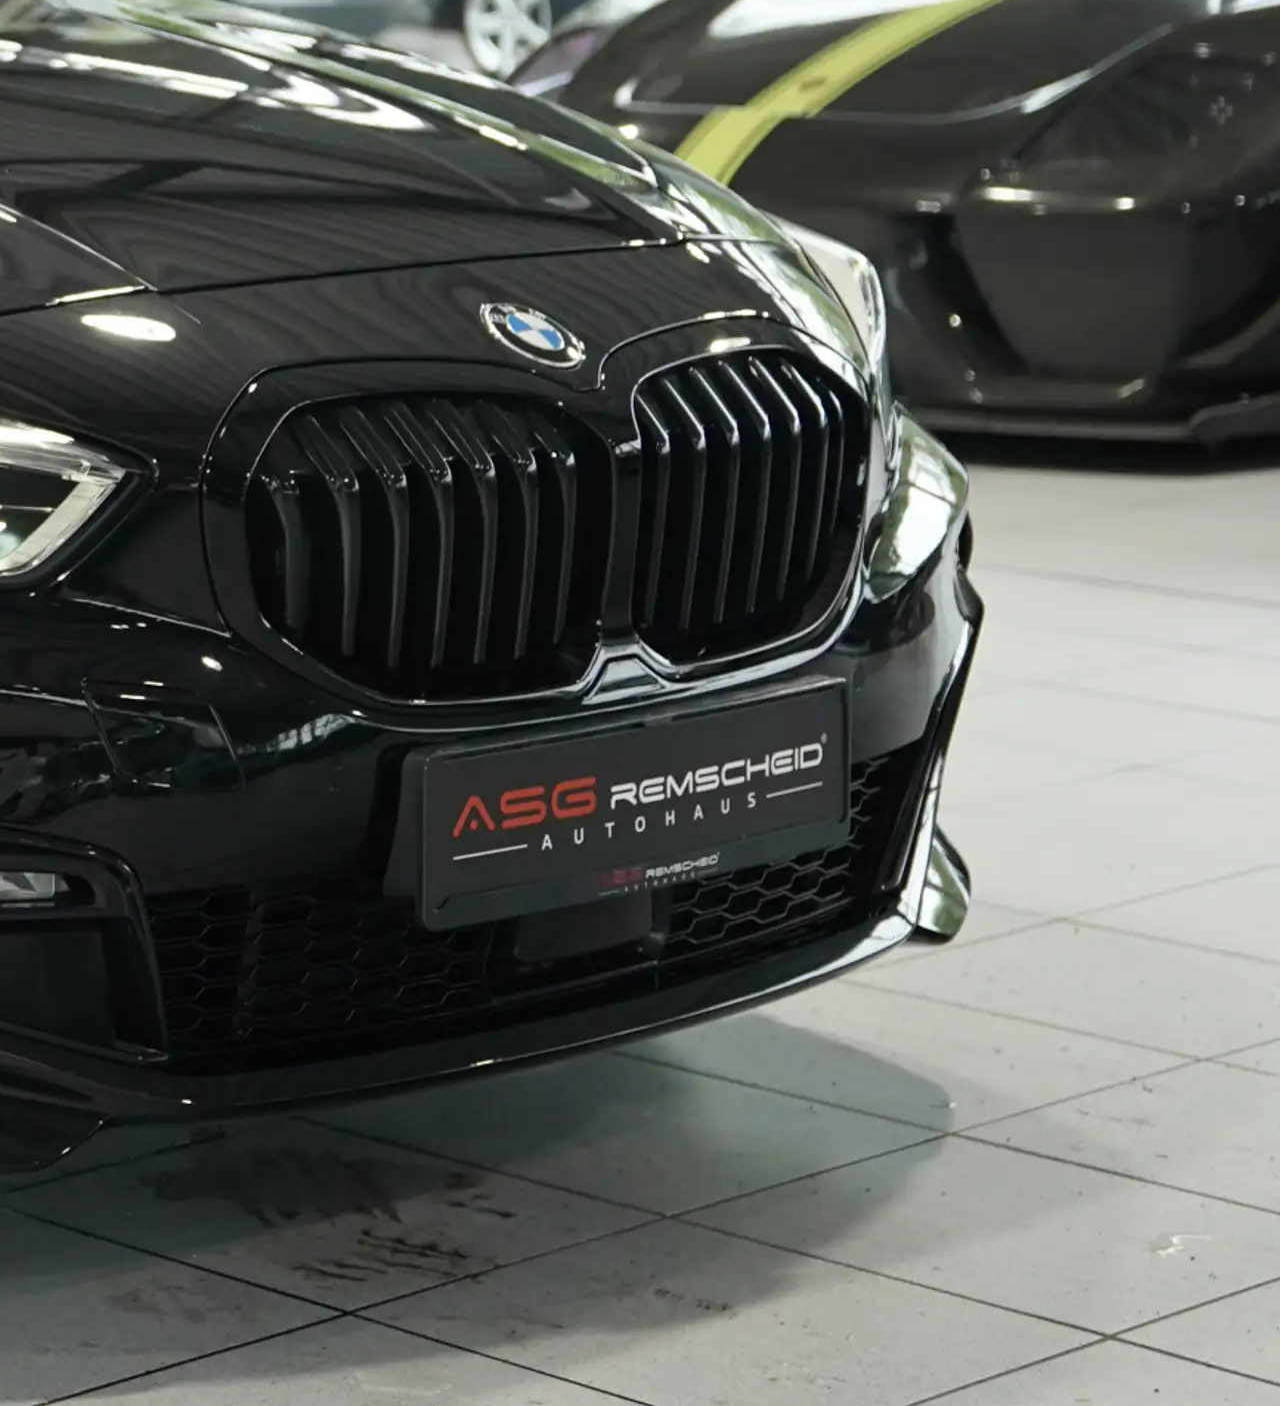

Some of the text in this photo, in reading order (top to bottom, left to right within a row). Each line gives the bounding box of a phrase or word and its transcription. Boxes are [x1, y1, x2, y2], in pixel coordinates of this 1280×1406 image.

[452, 741, 825, 838] ASG REMSCHEID
[540, 790, 758, 852] AUTOHAUS
